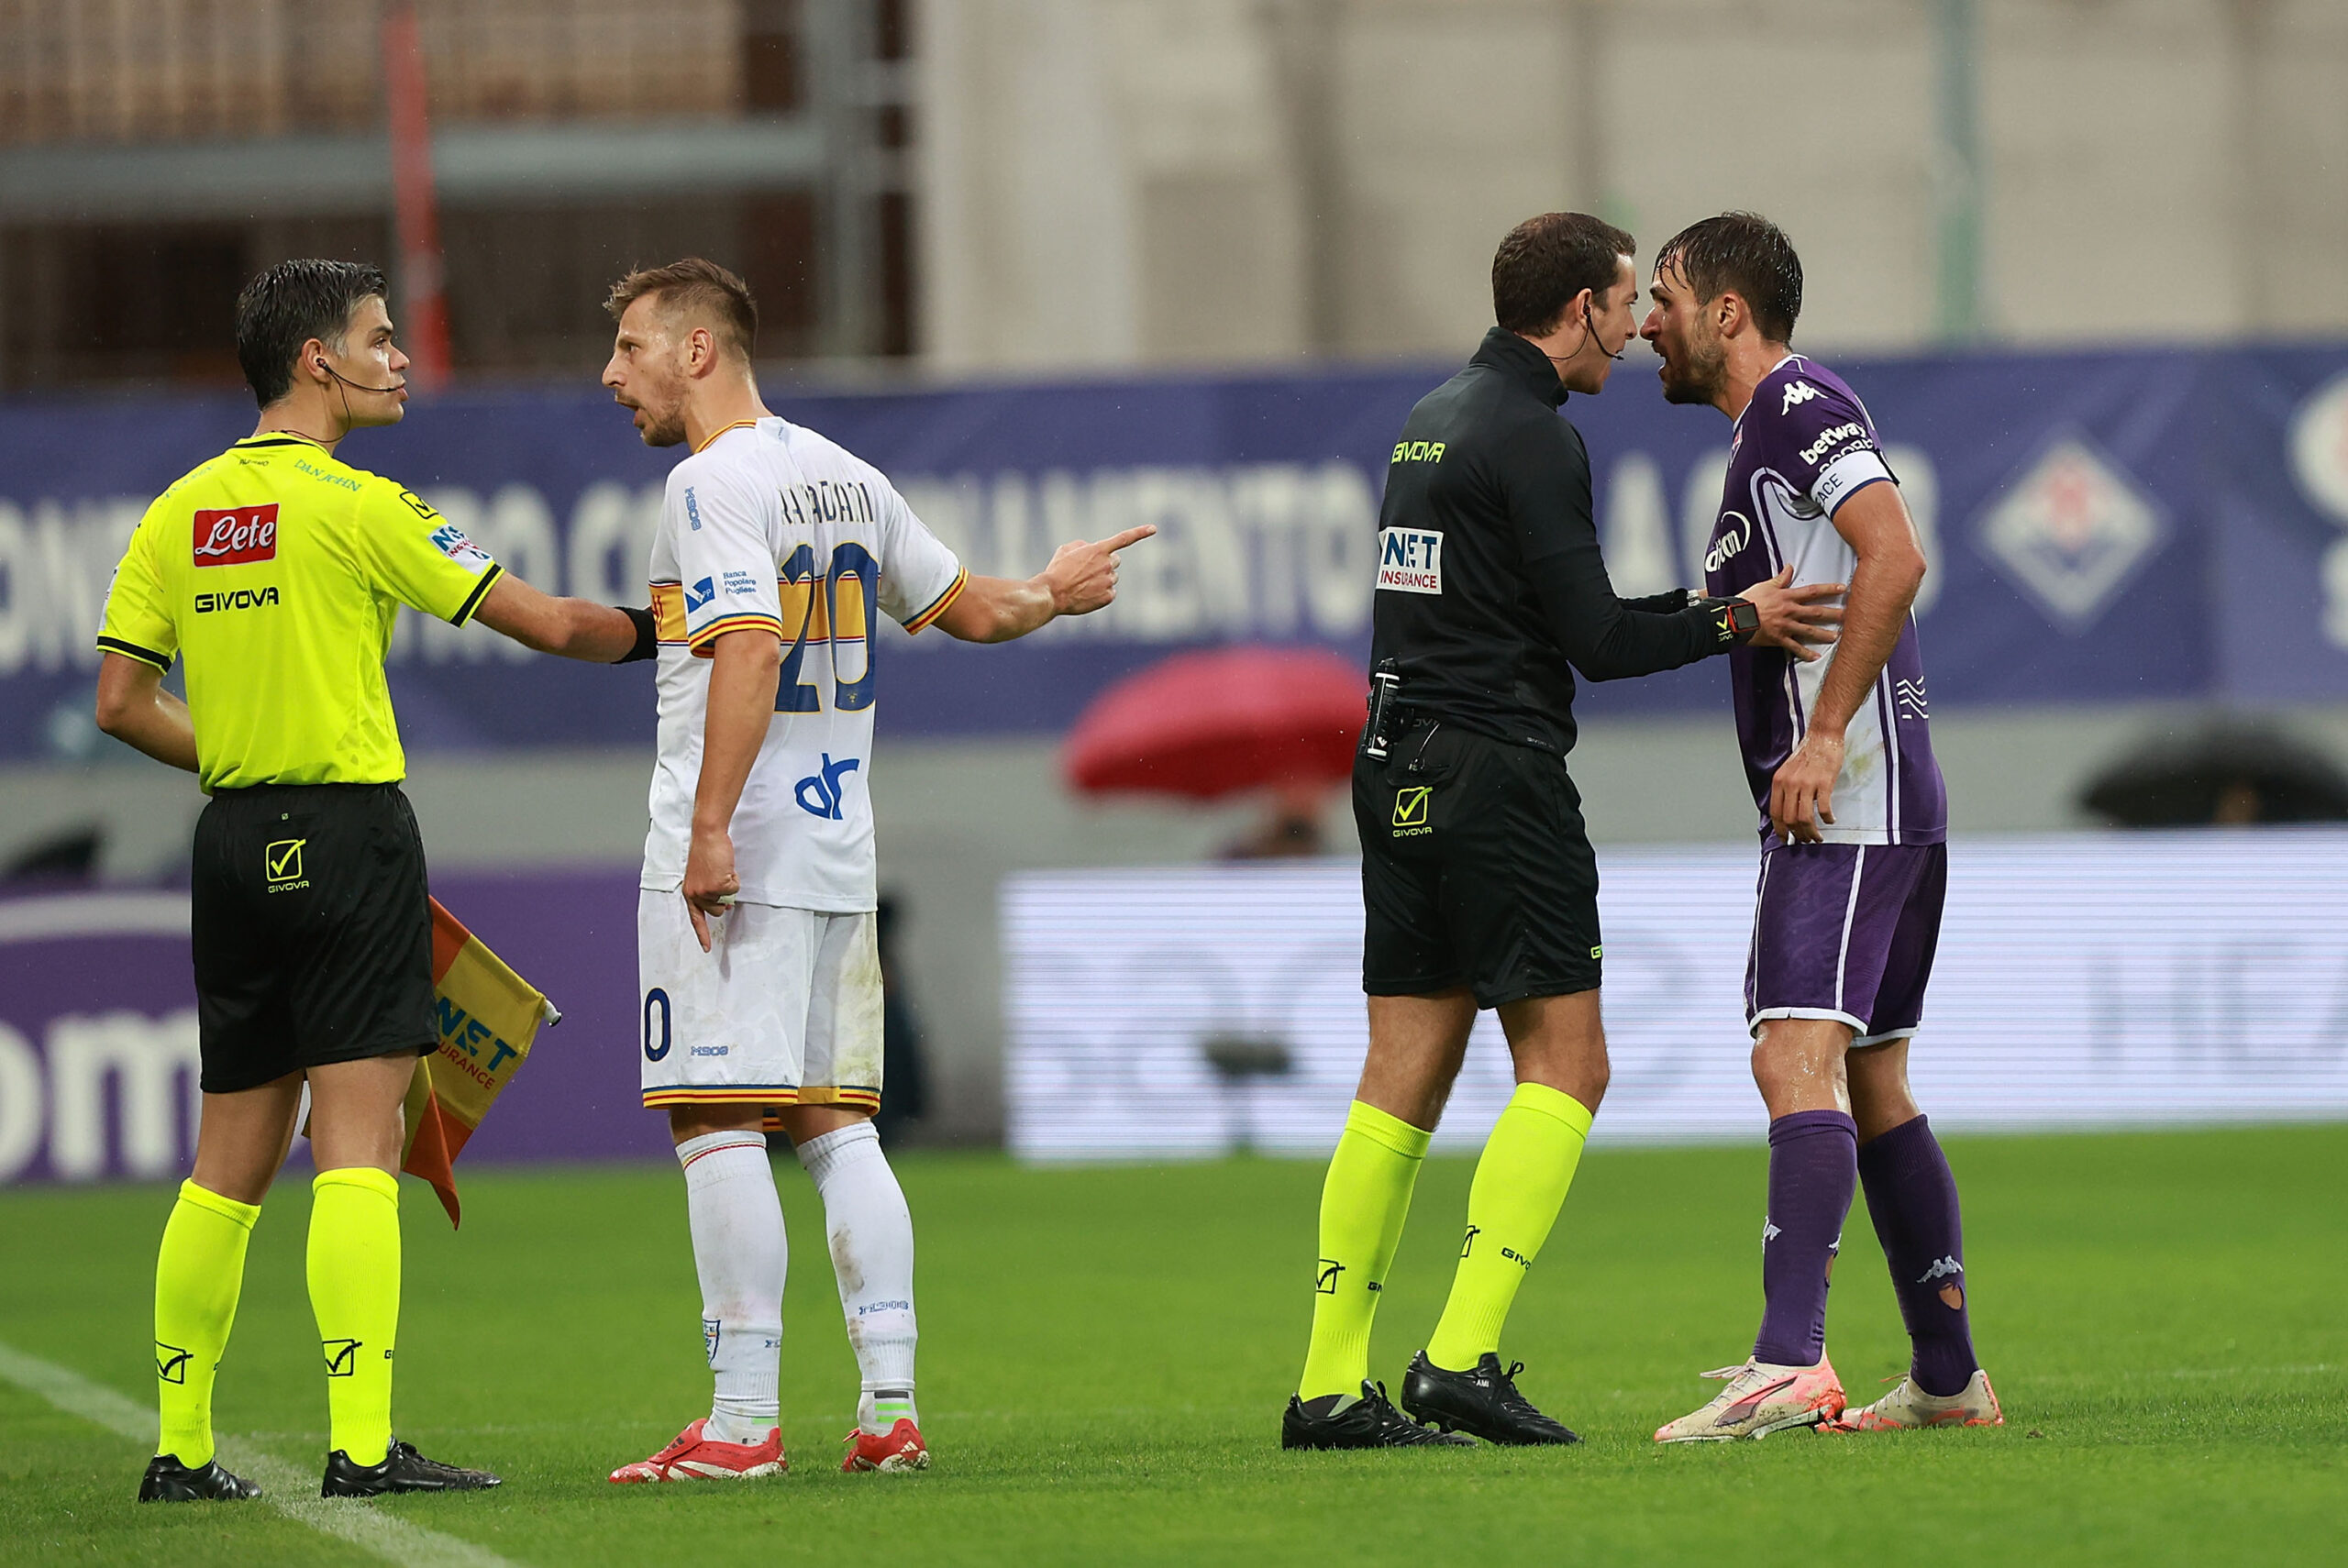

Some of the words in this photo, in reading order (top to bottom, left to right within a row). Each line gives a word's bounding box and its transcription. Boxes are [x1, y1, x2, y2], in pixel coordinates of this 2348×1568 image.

[1391, 441, 1445, 464] GIVOVA
[1799, 423, 1866, 466] betway
[294, 459, 325, 477] DAN
[317, 473, 362, 491] JOHN
[1815, 473, 1844, 506] ACE
[195, 515, 275, 556] Lete
[1384, 532, 1437, 569] NET
[723, 570, 748, 580] Banca
[725, 578, 757, 588] Popolare
[1380, 570, 1437, 589] INSURANCE
[195, 587, 279, 613] GIVOVA
[774, 540, 880, 712] 20
[1392, 826, 1433, 837] GIVOVA
[268, 880, 310, 893] GIVOVA
[438, 996, 517, 1072] NET
[438, 1041, 496, 1090] URANCE
